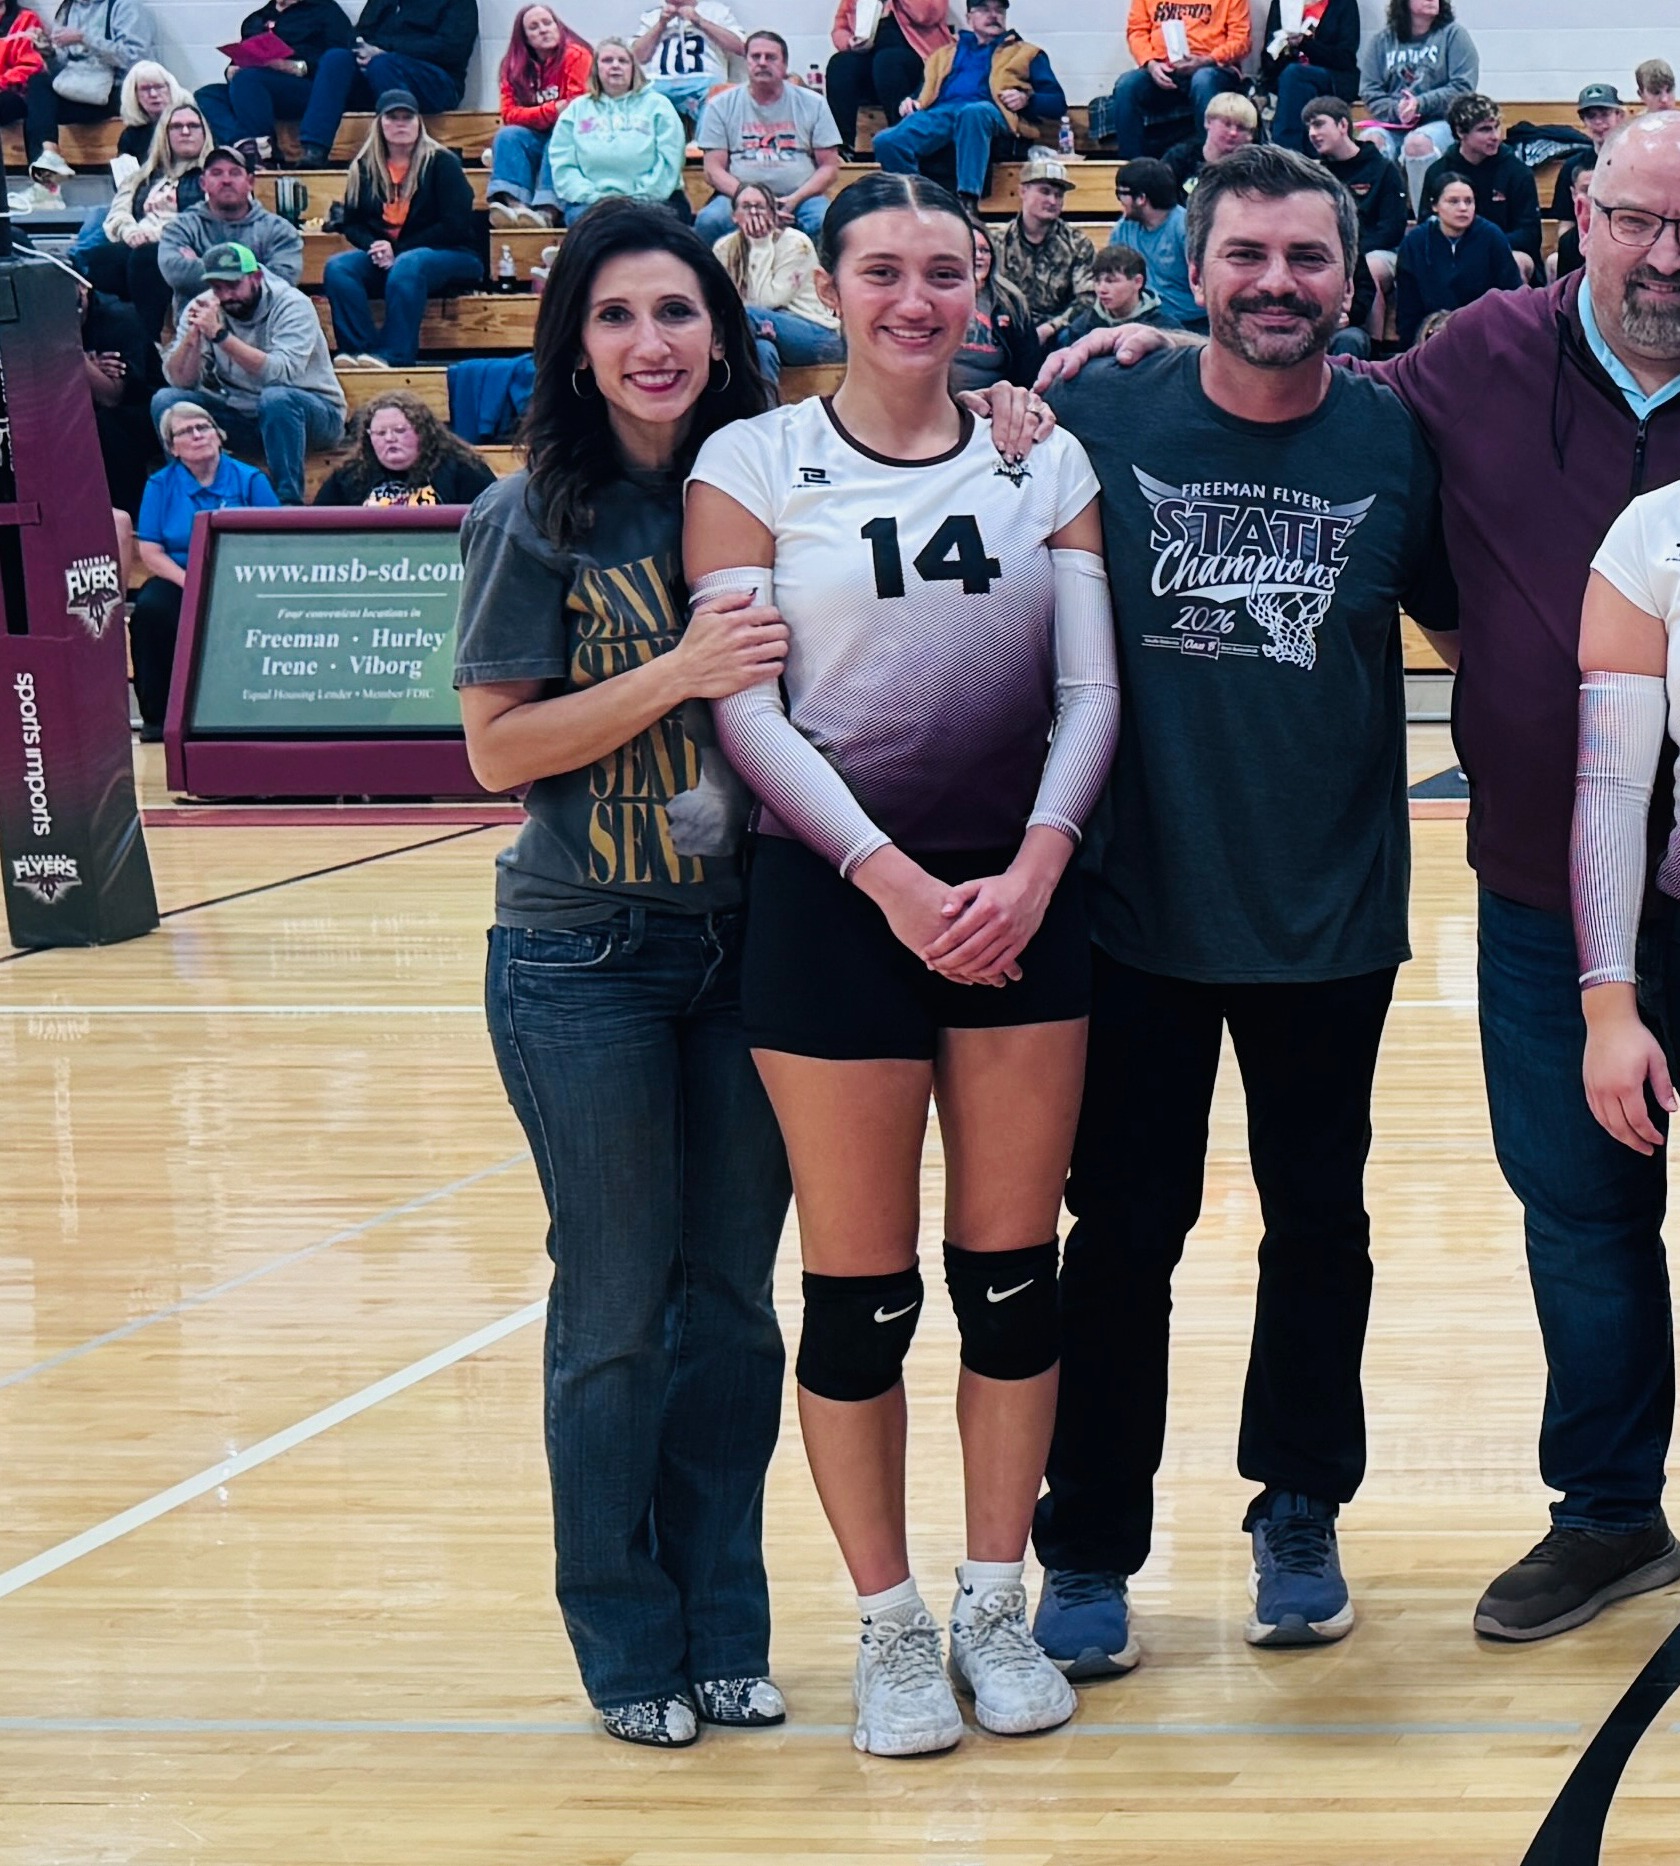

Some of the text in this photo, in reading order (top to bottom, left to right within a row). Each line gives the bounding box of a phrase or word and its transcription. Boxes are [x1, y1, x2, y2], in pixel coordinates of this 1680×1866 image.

[1181, 482, 1331, 514] FREEMAN FLYERS
[1150, 498, 1352, 572] STATE
[861, 515, 1002, 599] 14
[1151, 539, 1341, 600] Champions
[65, 560, 118, 600] FLYERS
[362, 608, 408, 618] locations
[410, 608, 421, 617] in
[1171, 605, 1236, 634] 2026
[245, 628, 445, 652] Freeman Hurley
[262, 655, 423, 679] Irene Viborg
[13, 672, 42, 745] sports
[274, 689, 315, 701] Housing
[363, 689, 403, 699] Member
[406, 688, 435, 699] FDIC
[13, 859, 78, 879] FLYERS
